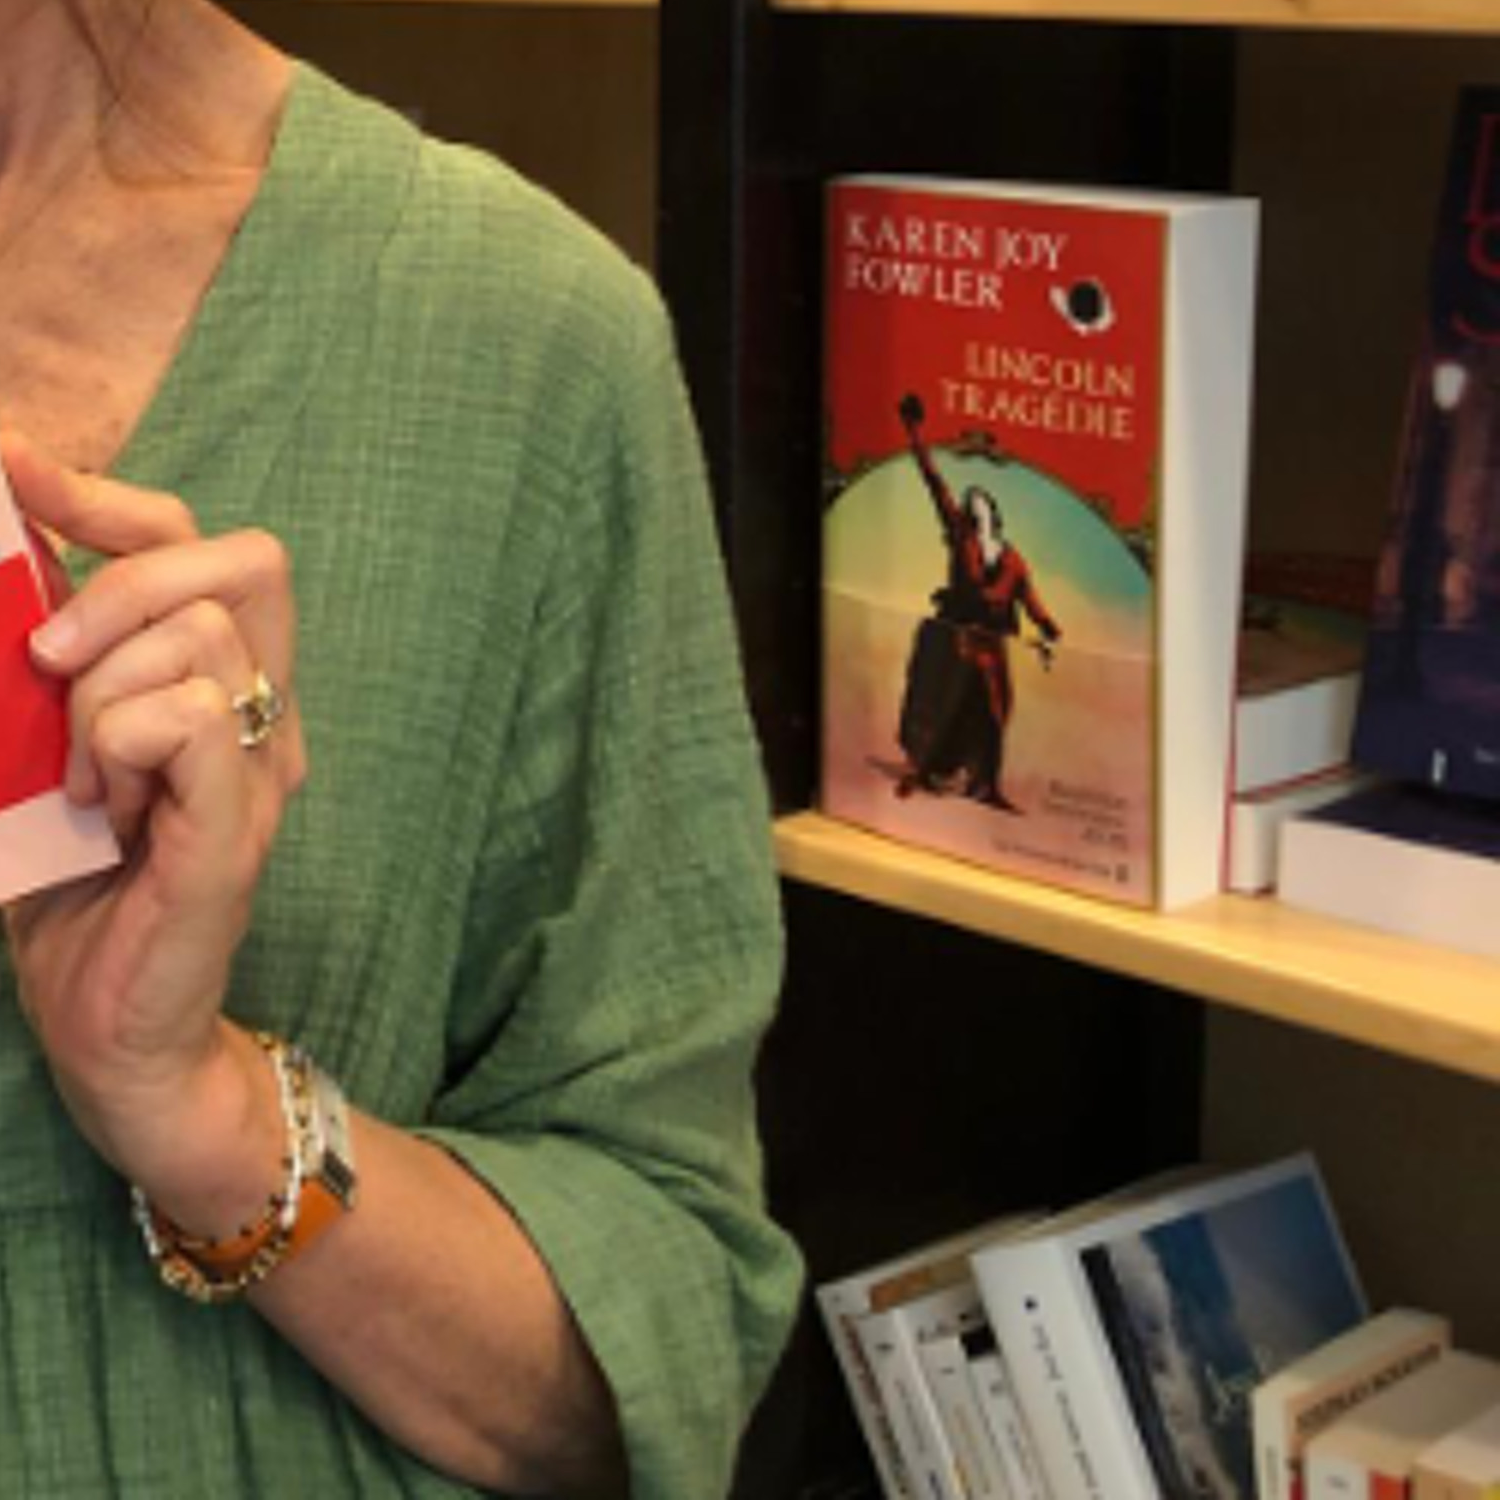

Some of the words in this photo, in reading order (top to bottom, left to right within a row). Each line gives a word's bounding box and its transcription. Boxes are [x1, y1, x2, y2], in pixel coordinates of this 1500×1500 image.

[845, 215, 985, 260] KAREN
[997, 228, 1067, 272] JOY
[845, 253, 1003, 309] FOWLER
[965, 341, 1134, 397] LINCOLN
[940, 380, 1134, 439] TRAGÉDIE
